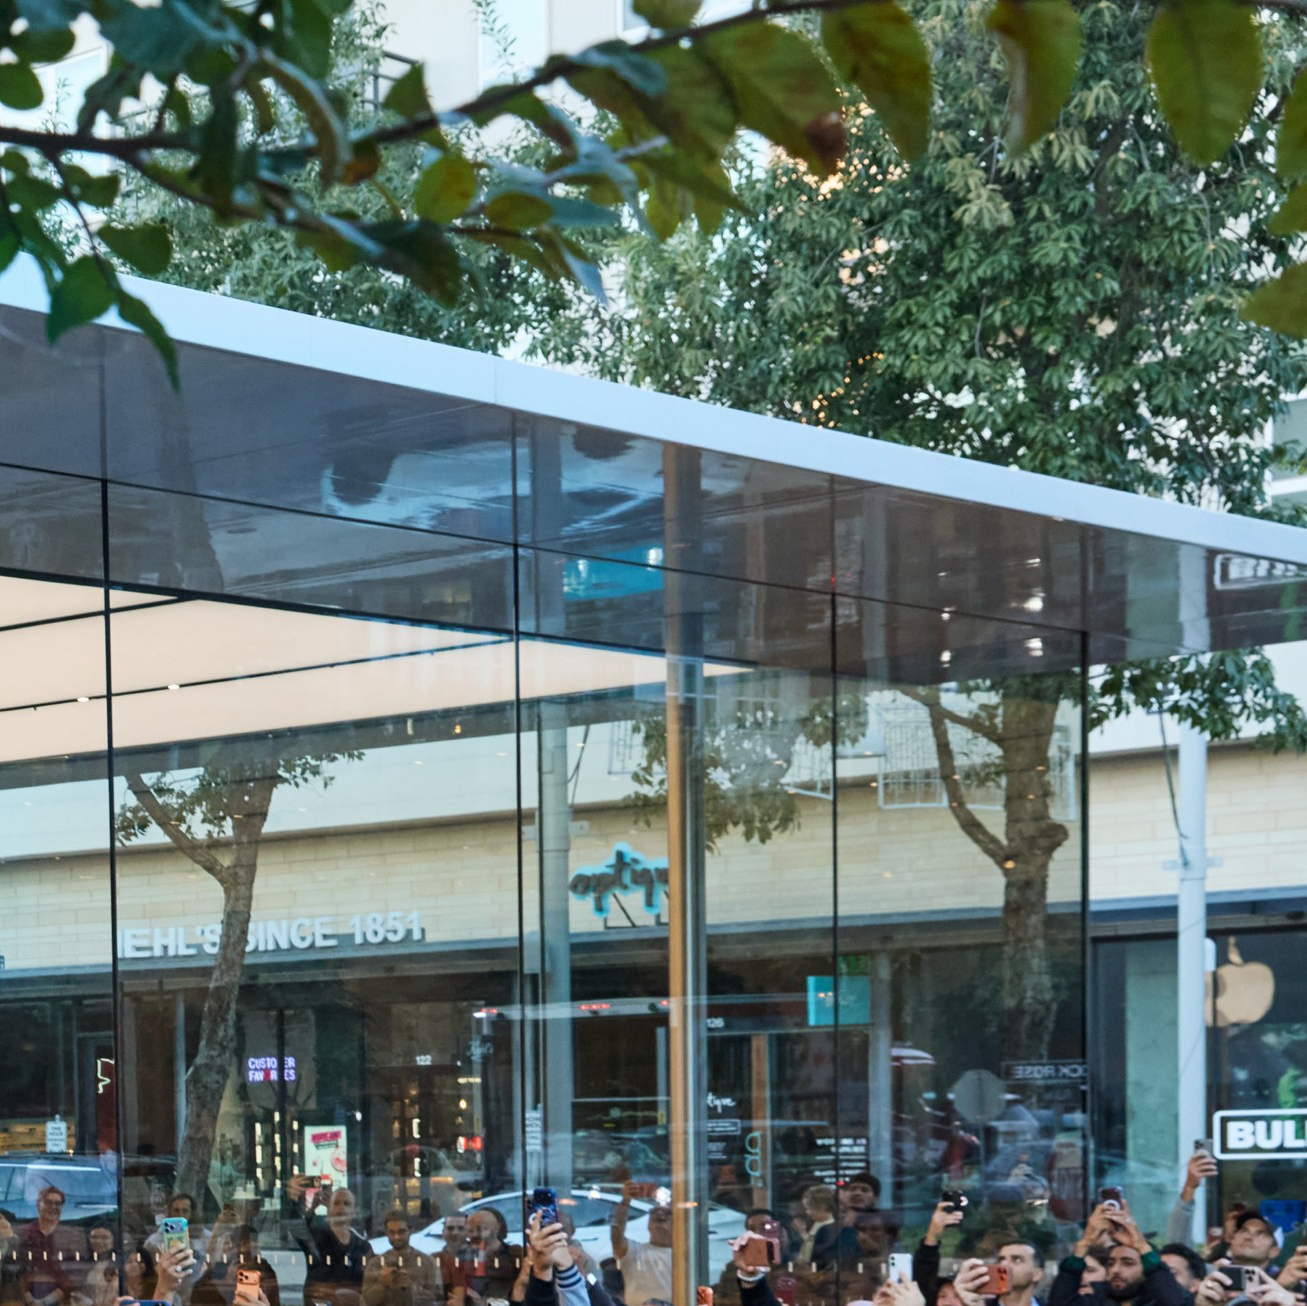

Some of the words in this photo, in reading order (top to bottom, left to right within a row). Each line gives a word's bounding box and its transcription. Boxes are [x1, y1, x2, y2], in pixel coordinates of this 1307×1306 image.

[117, 923, 222, 959] IEHL'S
[244, 917, 338, 952] SINCE
[349, 910, 423, 945] 1851
[248, 1057, 296, 1070] CUSTOER
[415, 1055, 432, 1066] 122
[248, 1069, 296, 1082] FAVORES
[1227, 1119, 1307, 1150] BUL
